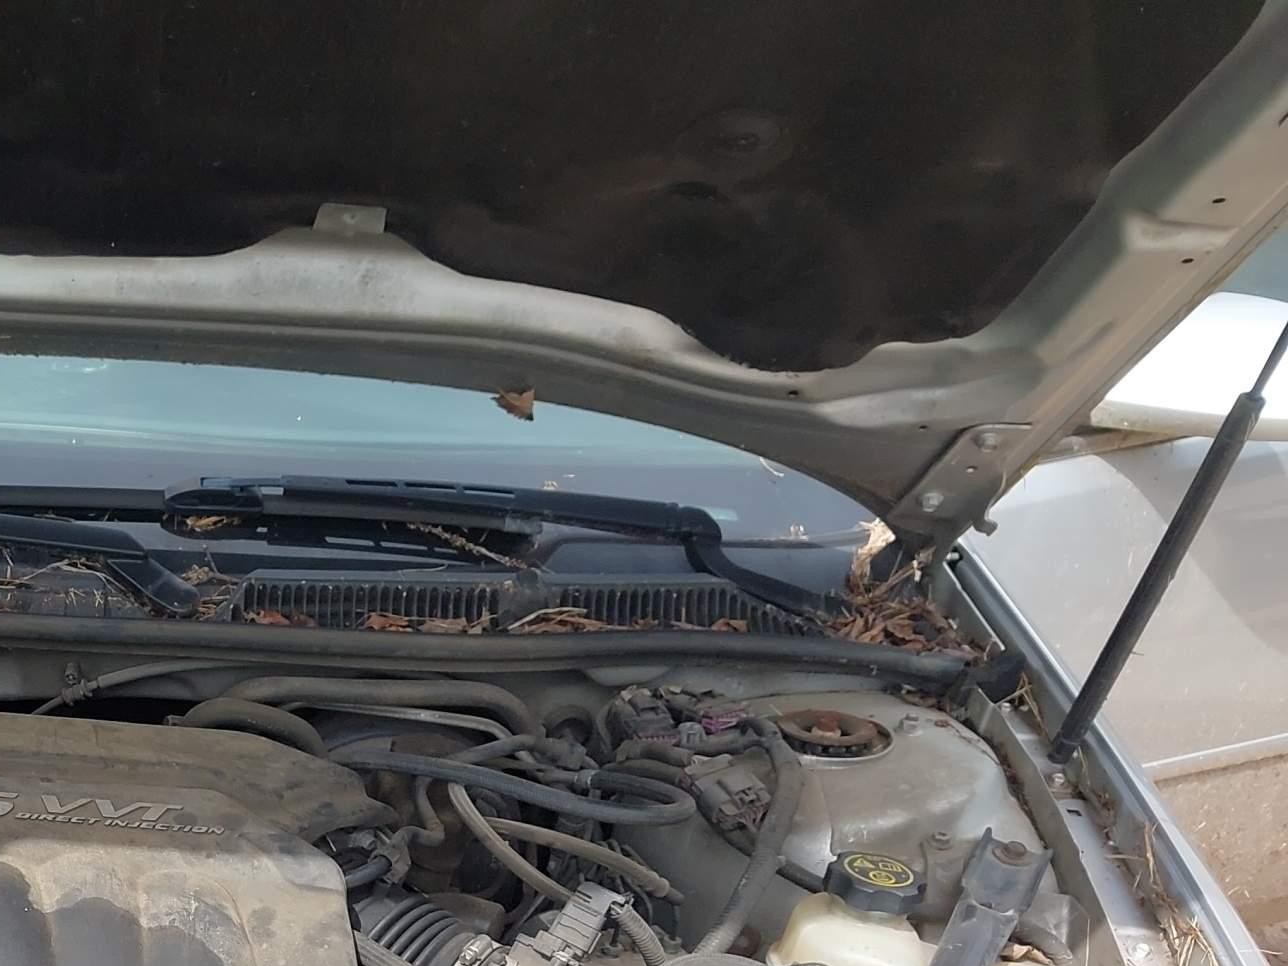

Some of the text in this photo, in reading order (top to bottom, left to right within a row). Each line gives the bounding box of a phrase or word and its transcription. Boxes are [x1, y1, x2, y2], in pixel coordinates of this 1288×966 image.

[40, 794, 184, 821] VVT
[15, 811, 225, 836] DIRECT INJECTION
